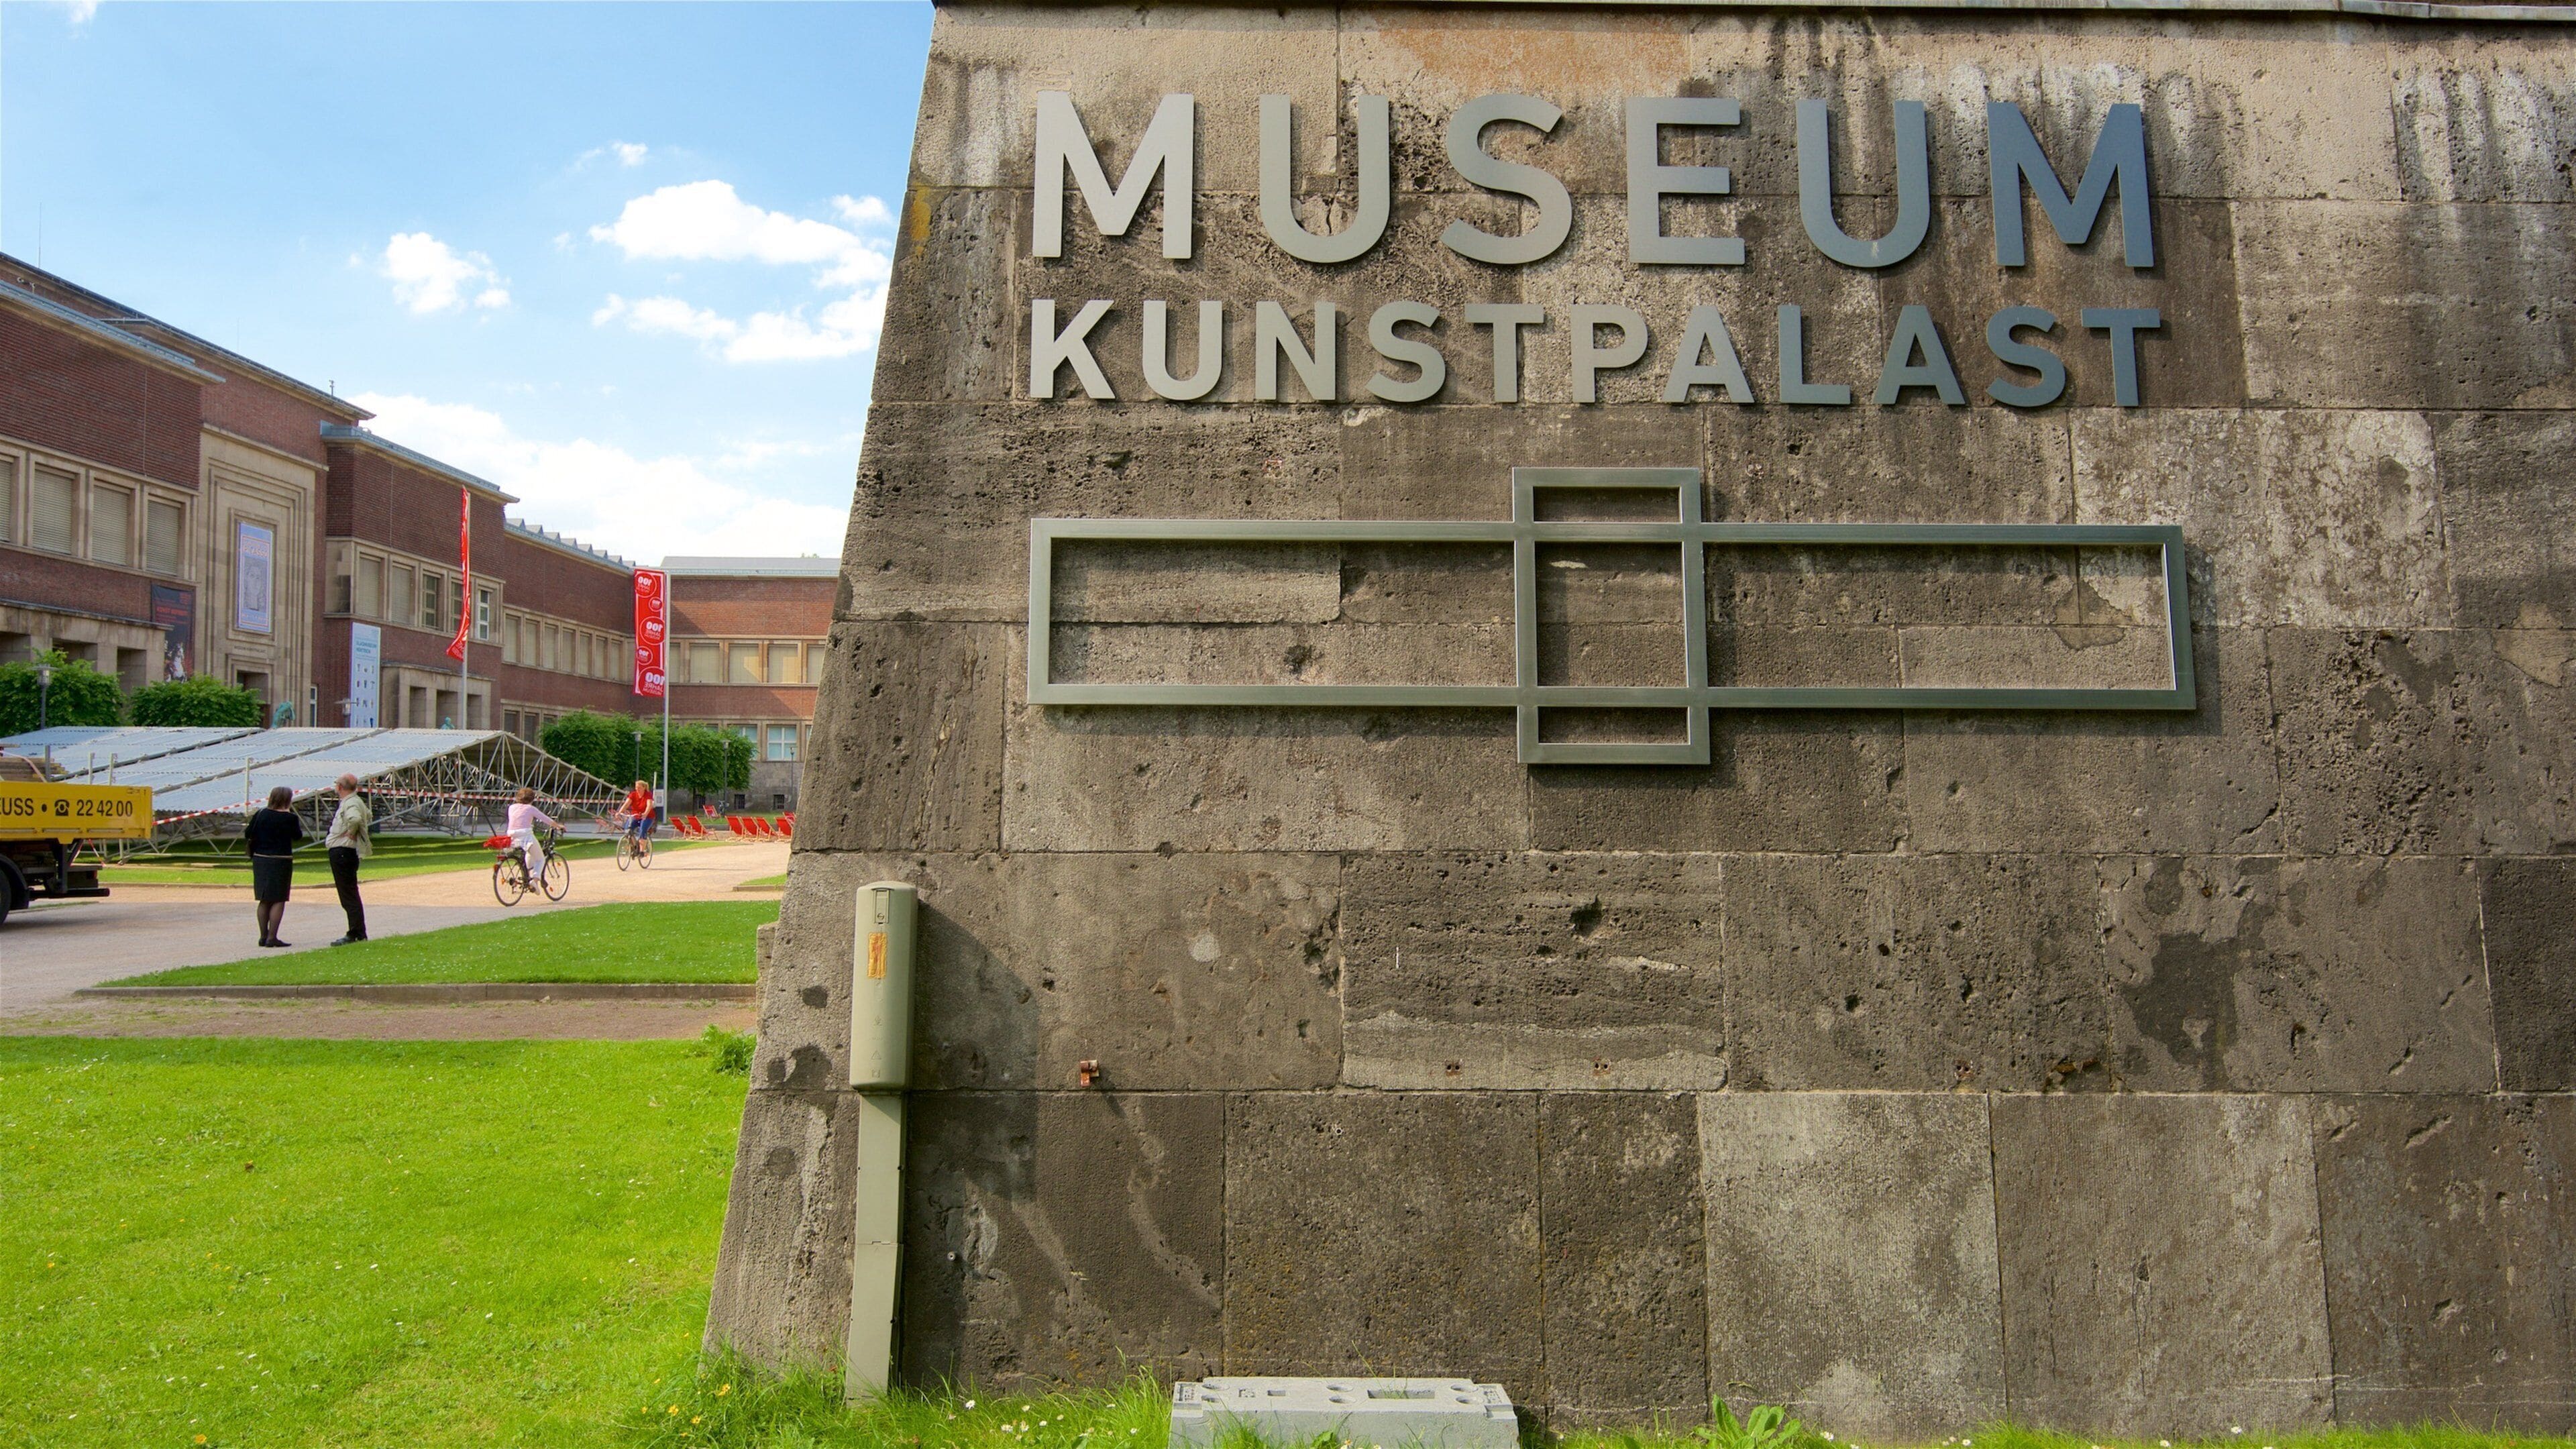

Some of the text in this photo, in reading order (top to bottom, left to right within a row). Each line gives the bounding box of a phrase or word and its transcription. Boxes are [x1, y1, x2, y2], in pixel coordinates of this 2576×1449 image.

[1032, 91, 2154, 268] MUSEUM
[1030, 299, 2160, 408] KUNSTPALAST
[0, 798, 34, 816] USS
